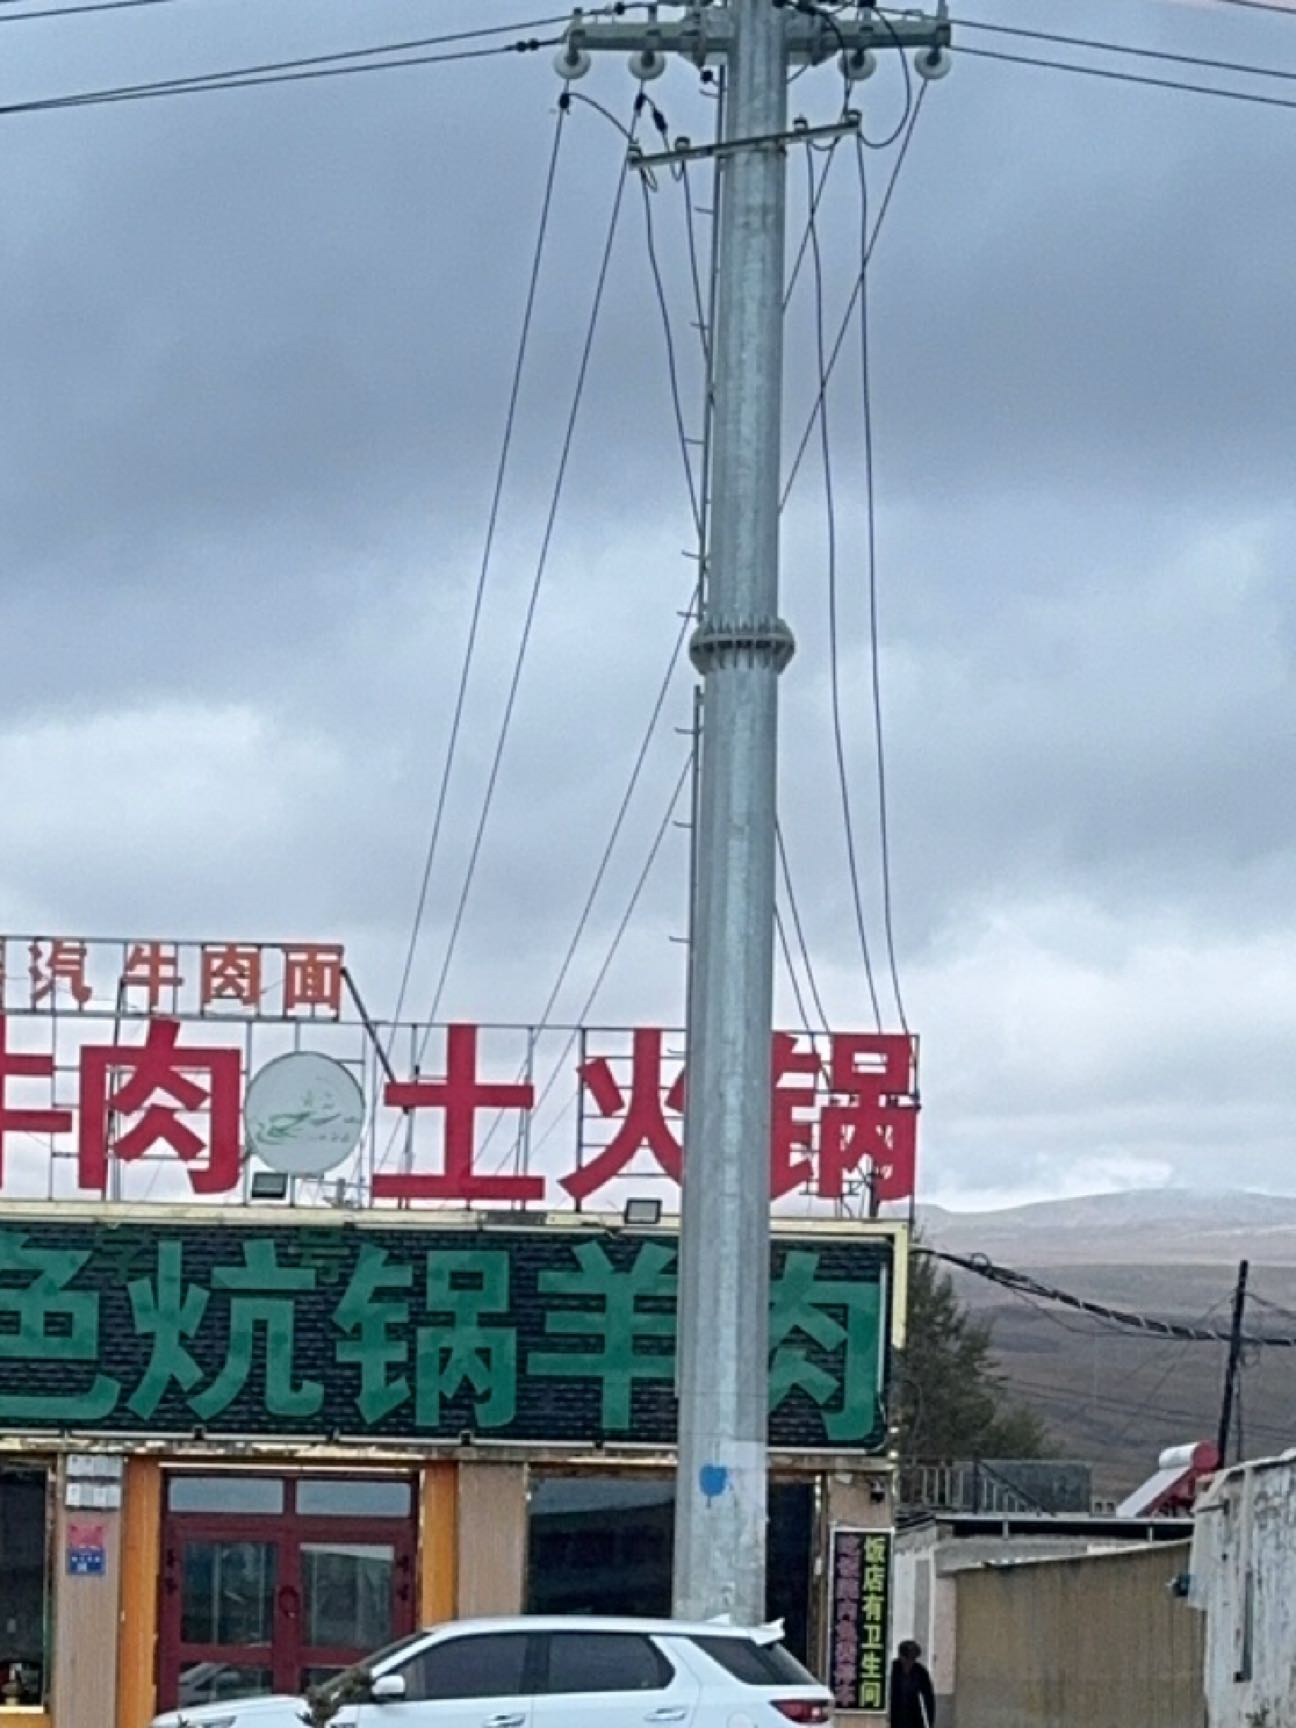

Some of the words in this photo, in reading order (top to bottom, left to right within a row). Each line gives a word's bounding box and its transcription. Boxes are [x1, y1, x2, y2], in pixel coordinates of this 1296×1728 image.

[371, 1022, 917, 1201] 土火锅
[858, 1534, 887, 1708] 饭店有卫生间
